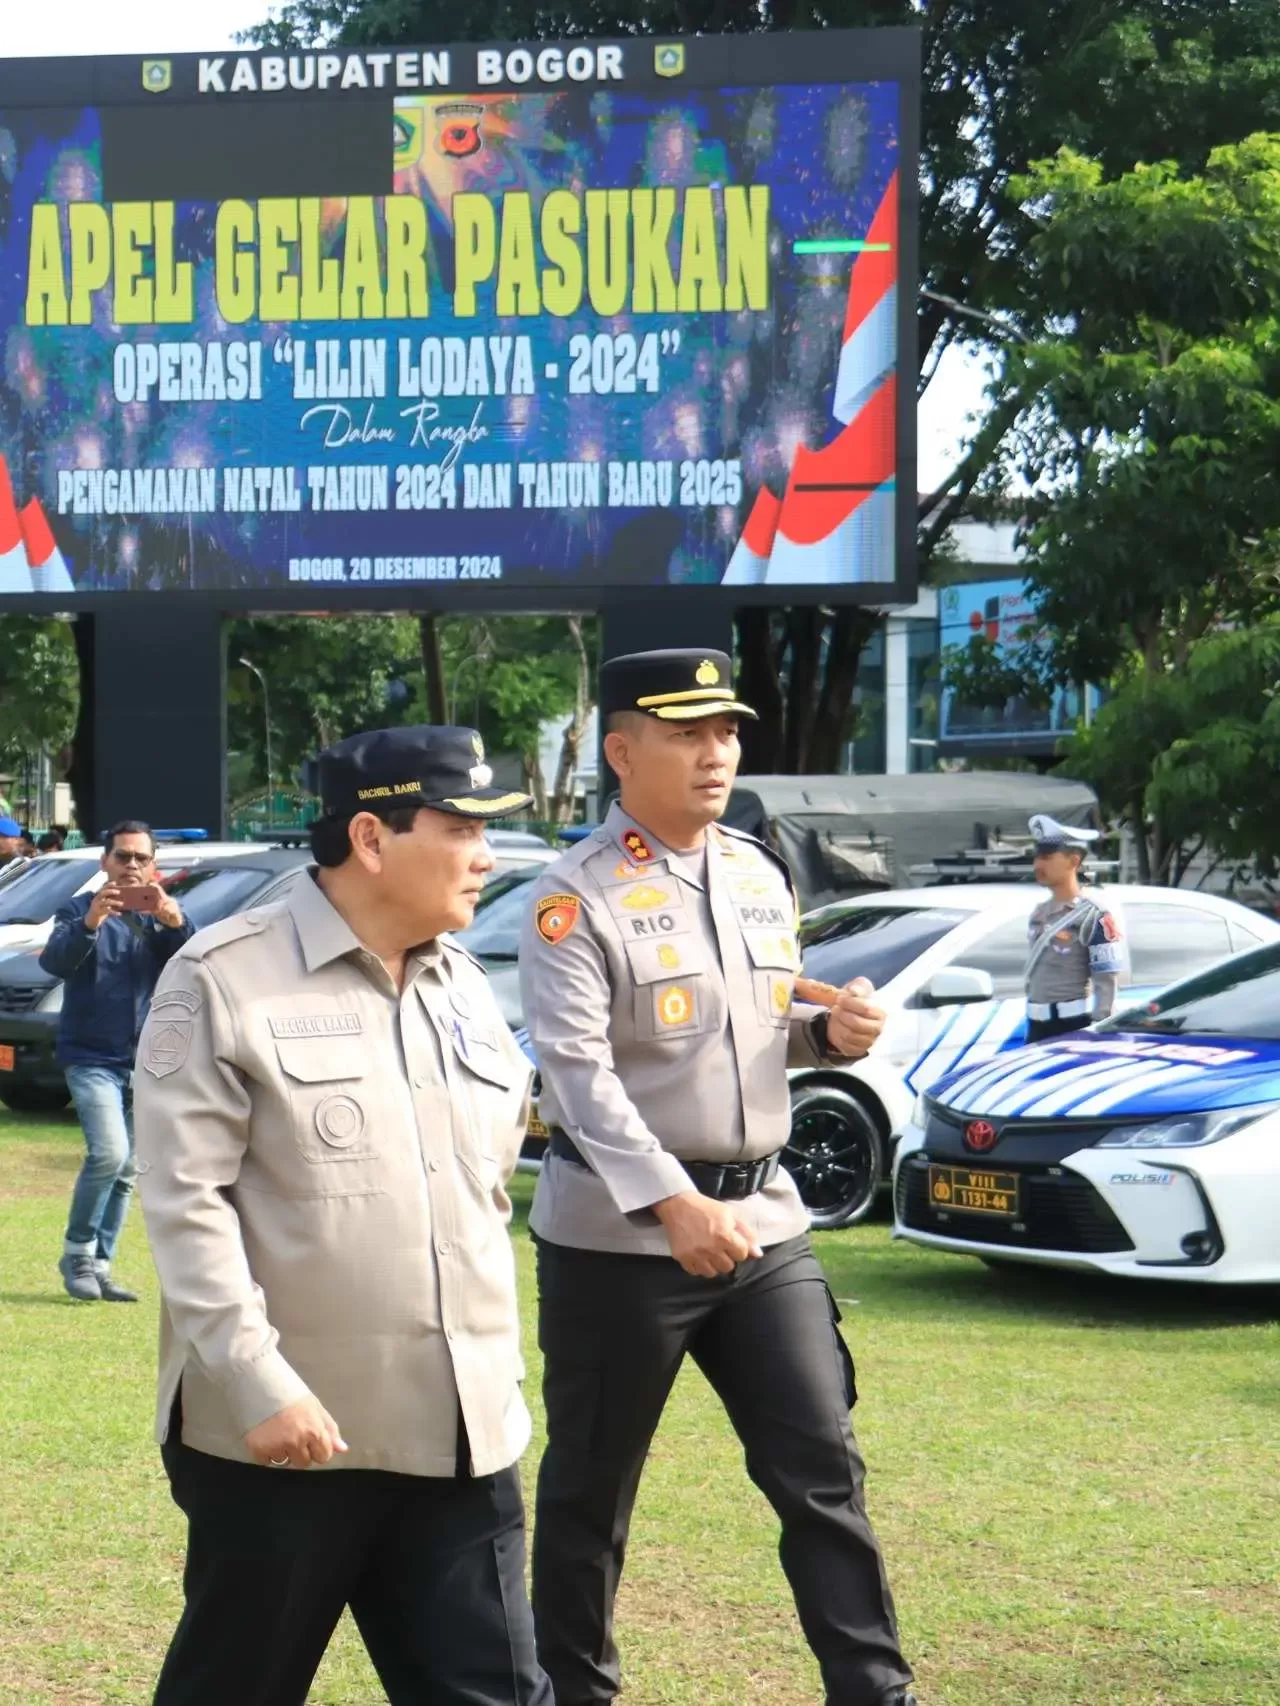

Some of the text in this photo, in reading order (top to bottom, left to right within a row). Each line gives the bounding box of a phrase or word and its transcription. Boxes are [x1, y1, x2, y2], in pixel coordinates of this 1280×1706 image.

[198, 45, 625, 92] KABUPATEN BOGOR
[25, 185, 770, 326] APEL GELAR PASUKAN
[113, 341, 262, 403] OPERASI
[273, 337, 387, 399] “LILIN
[397, 335, 536, 397] LODAYA
[568, 329, 681, 394] 2024”
[300, 399, 489, 474] Dalam Rangka
[57, 459, 742, 515] PENGAMANAN NATAL TAHUN 2024 DAN TAHUN BARU 2025
[289, 556, 501, 582] BOGOR, 20 DESEMBER 2024
[631, 915, 675, 935] RIO
[741, 907, 786, 925] POLRI
[969, 1174, 995, 1189] VIII
